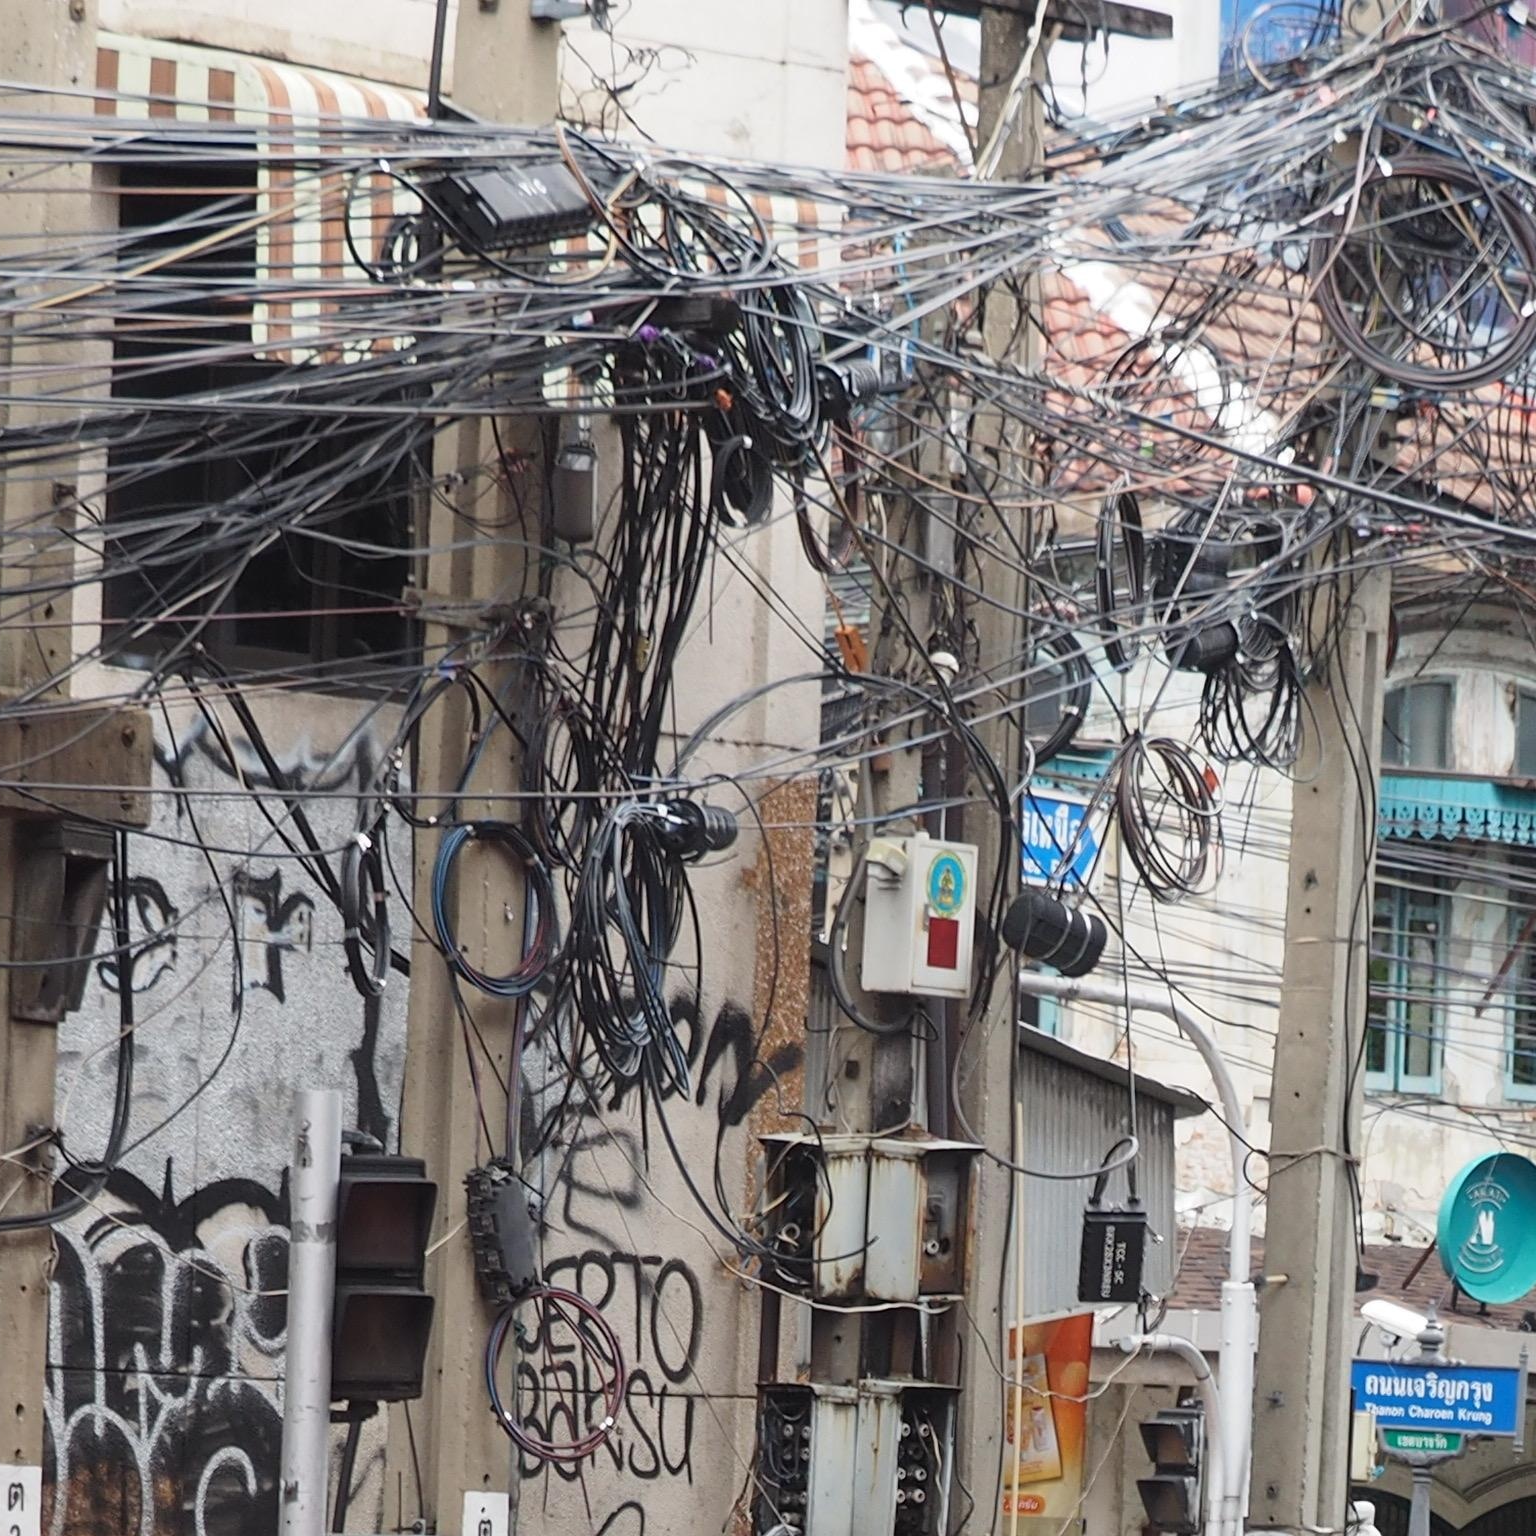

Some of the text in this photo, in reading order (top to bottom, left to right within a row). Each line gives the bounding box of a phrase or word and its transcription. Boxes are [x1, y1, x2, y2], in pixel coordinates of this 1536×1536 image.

[1365, 1371, 1494, 1409] ถนนเจริญกรุง
[1365, 1402, 1493, 1425] Thanon Charoen Krung
